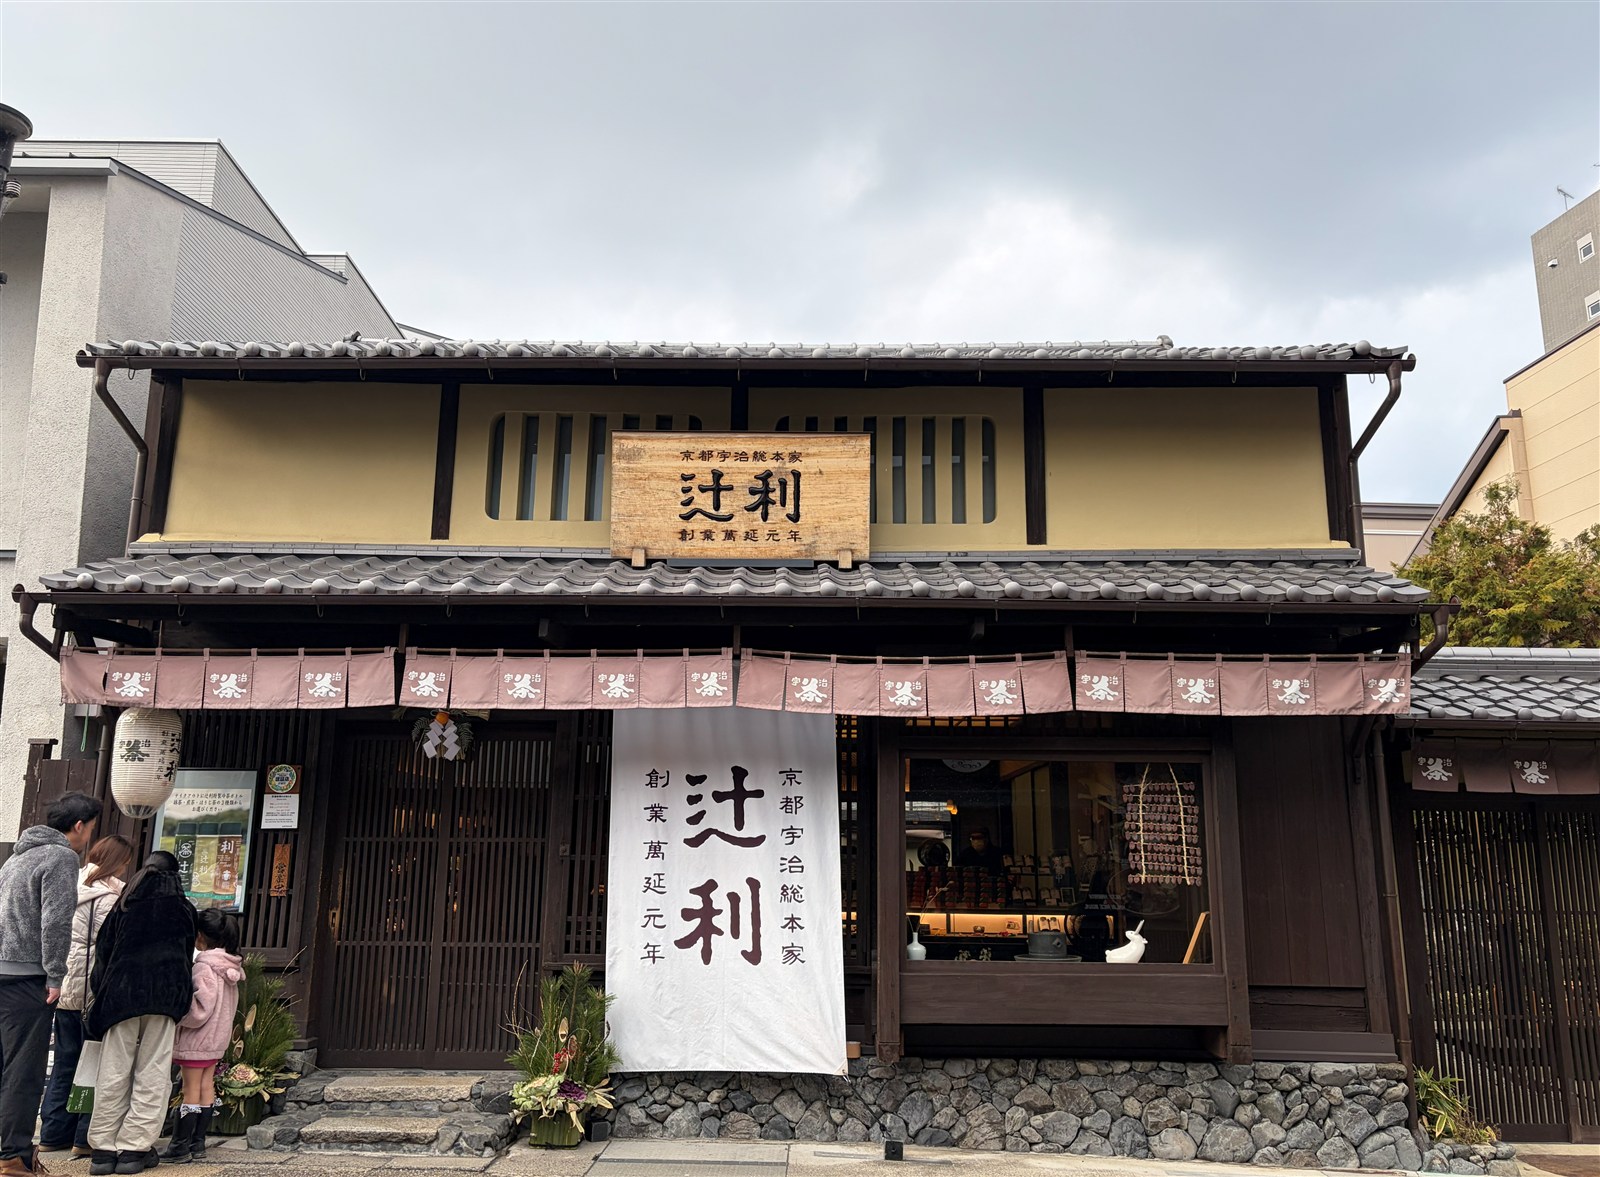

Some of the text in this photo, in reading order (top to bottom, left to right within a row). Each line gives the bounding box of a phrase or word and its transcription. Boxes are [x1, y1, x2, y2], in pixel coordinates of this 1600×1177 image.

[679, 450, 803, 463] 京都宇治総本家
[678, 468, 802, 523] 辻利
[678, 528, 803, 543] 創業萬延元年
[221, 840, 235, 854] 利
[640, 767, 670, 965] 創業萬延元年
[673, 765, 767, 966] 辻利
[778, 767, 806, 966] 京都宇治総本家
